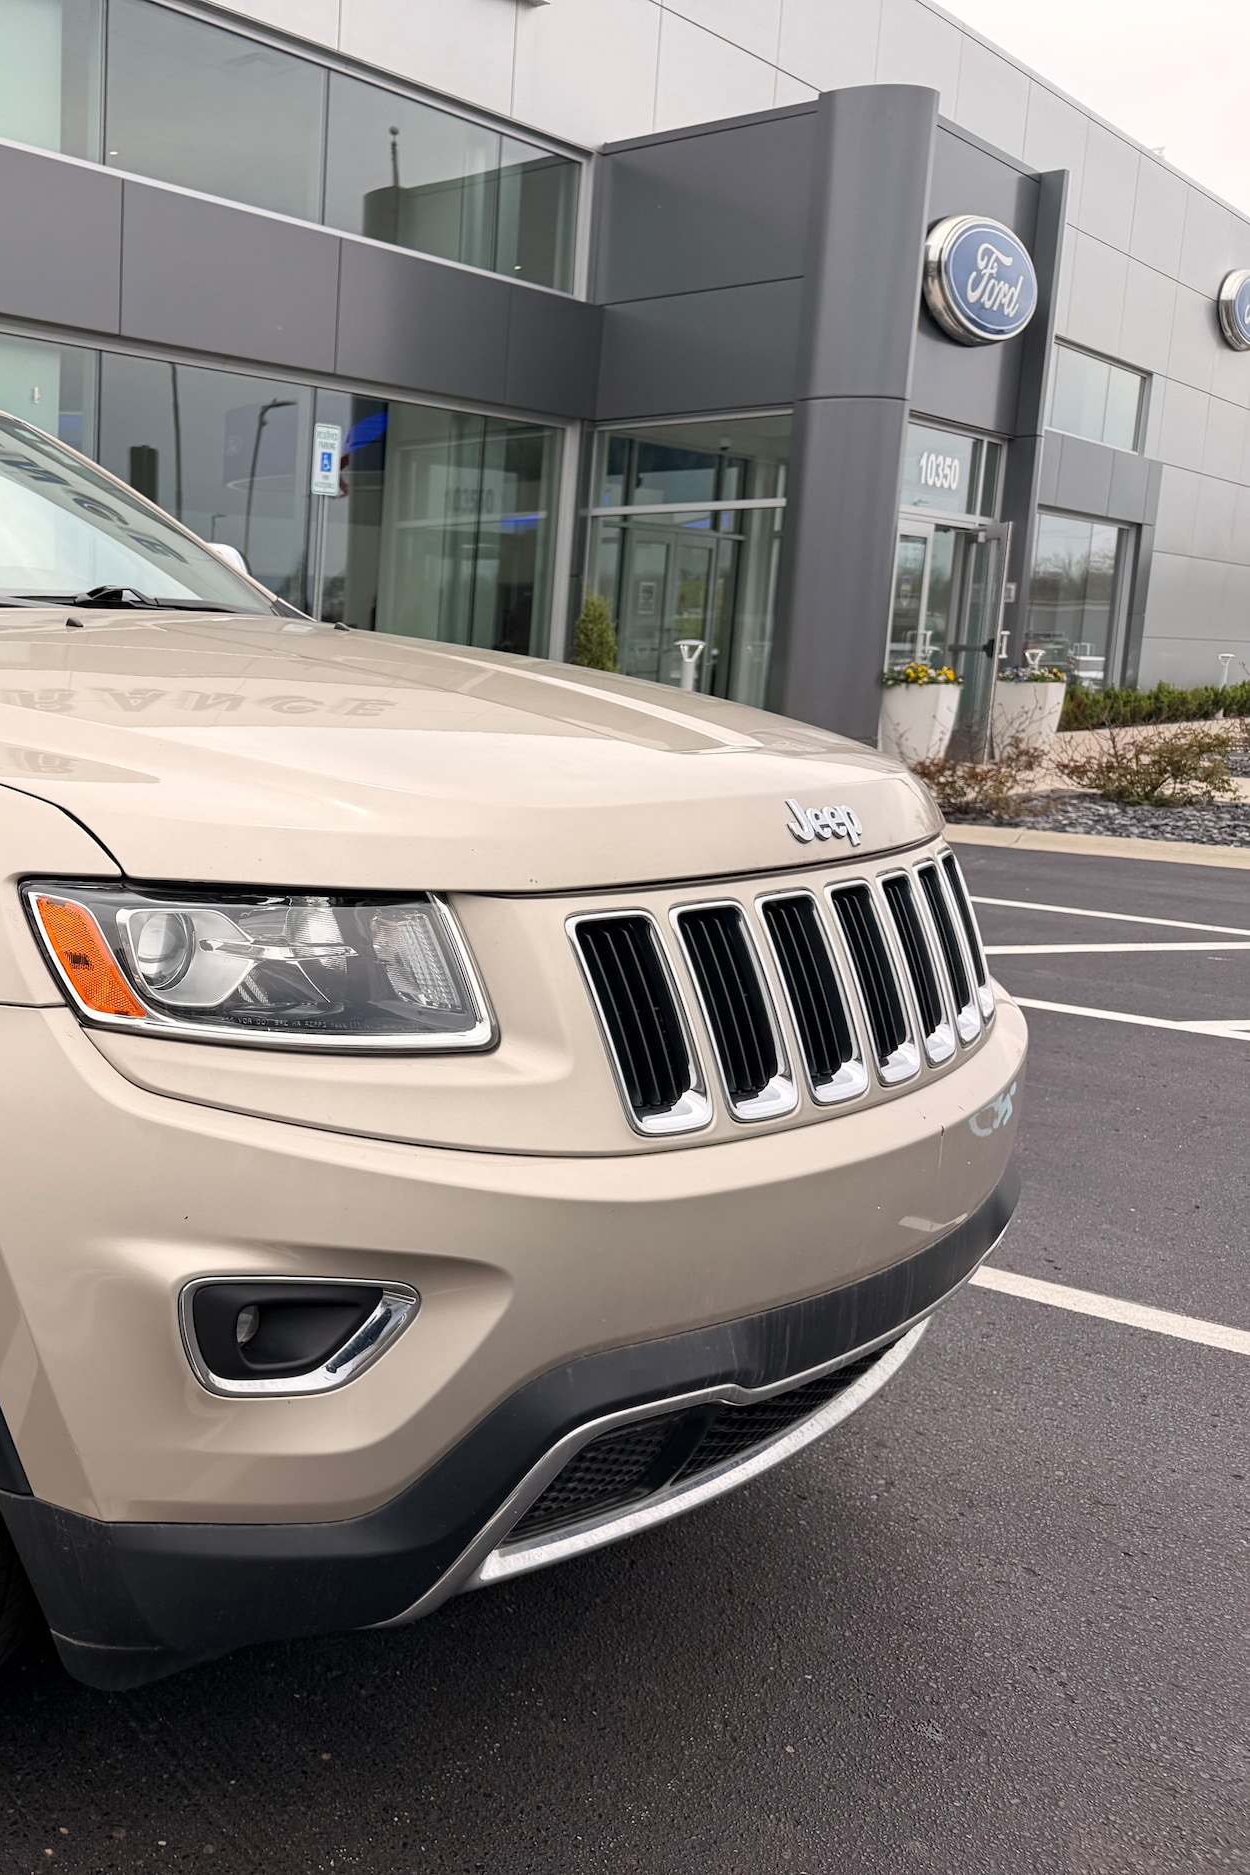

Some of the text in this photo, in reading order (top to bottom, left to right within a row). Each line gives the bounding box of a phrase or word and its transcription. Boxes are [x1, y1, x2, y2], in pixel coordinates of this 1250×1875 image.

[967, 243, 1023, 318] Ford
[919, 451, 959, 490] 10350
[785, 798, 863, 848] Jeep
